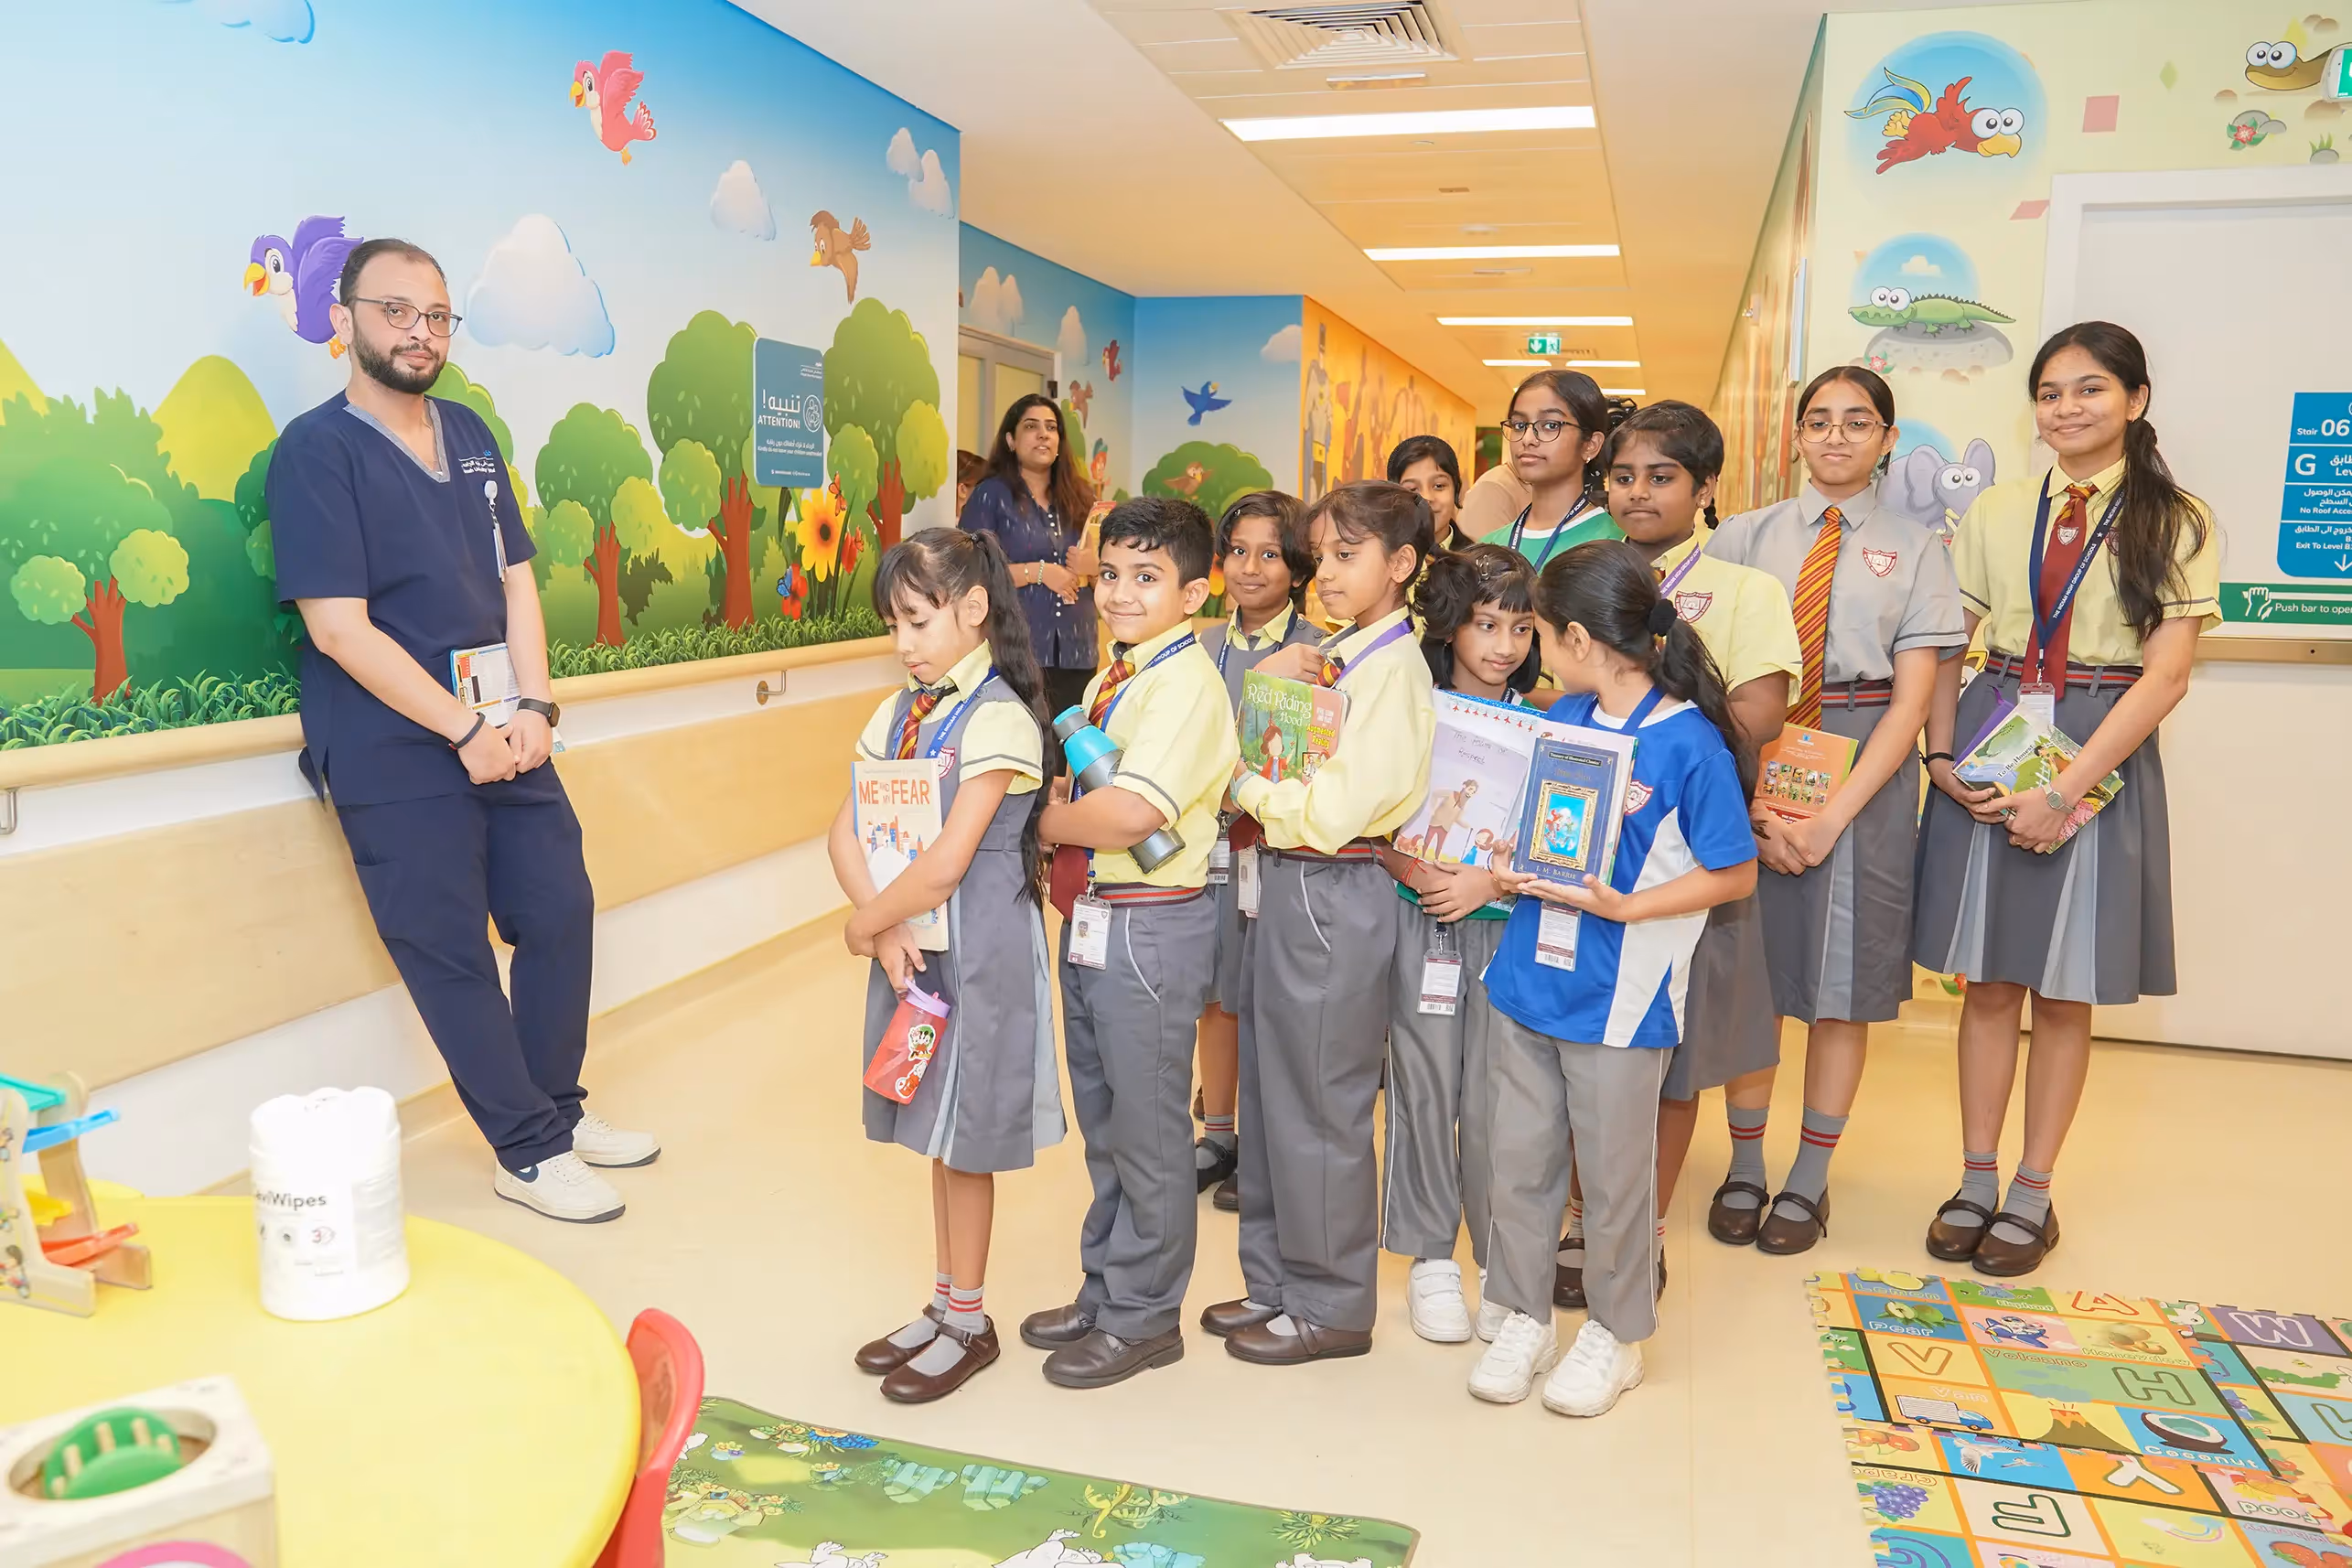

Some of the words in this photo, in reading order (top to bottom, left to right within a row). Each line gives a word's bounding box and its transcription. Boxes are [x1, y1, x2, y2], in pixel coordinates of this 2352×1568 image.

[757, 414, 800, 429] ATTENTION!
[2296, 427, 2318, 435] Stair
[2321, 419, 2351, 437] 06
[2294, 453, 2316, 476] G
[2304, 488, 2334, 498] الوصول
[2052, 609, 2061, 619] THE
[2057, 595, 2068, 610] INDIAN
[2066, 583, 2075, 596] HIGH
[2071, 568, 2082, 585] GROUP
[2083, 542, 2097, 563] SCHOOLS
[2275, 602, 2299, 612] Push
[2301, 603, 2318, 613] bar
[2319, 605, 2330, 613] to
[1153, 650, 1171, 662] GROUP
[1247, 682, 1273, 706] Red
[1273, 690, 1313, 720] Riding
[937, 731, 947, 741] THE
[943, 714, 957, 732] INDIAN
[954, 703, 965, 716] HIGH
[1280, 711, 1304, 726] Hood
[1306, 724, 1336, 738] Augmented
[1312, 734, 1330, 750] Reality
[1997, 769, 2006, 778] To
[858, 780, 879, 805] ME
[890, 779, 930, 805] FEAR
[1552, 868, 1576, 879] BARRIE
[1854, 1282, 1940, 1300] Lemon
[1868, 1320, 1934, 1337] Pear
[2228, 1311, 2314, 1348] W
[1886, 1341, 1953, 1376] V
[1982, 1348, 2088, 1369] Volcano
[1928, 1385, 1990, 1403] Van
[2110, 1366, 2196, 1406] H
[2144, 1444, 2259, 1469] Coconut
[2237, 1499, 2321, 1526] Food
